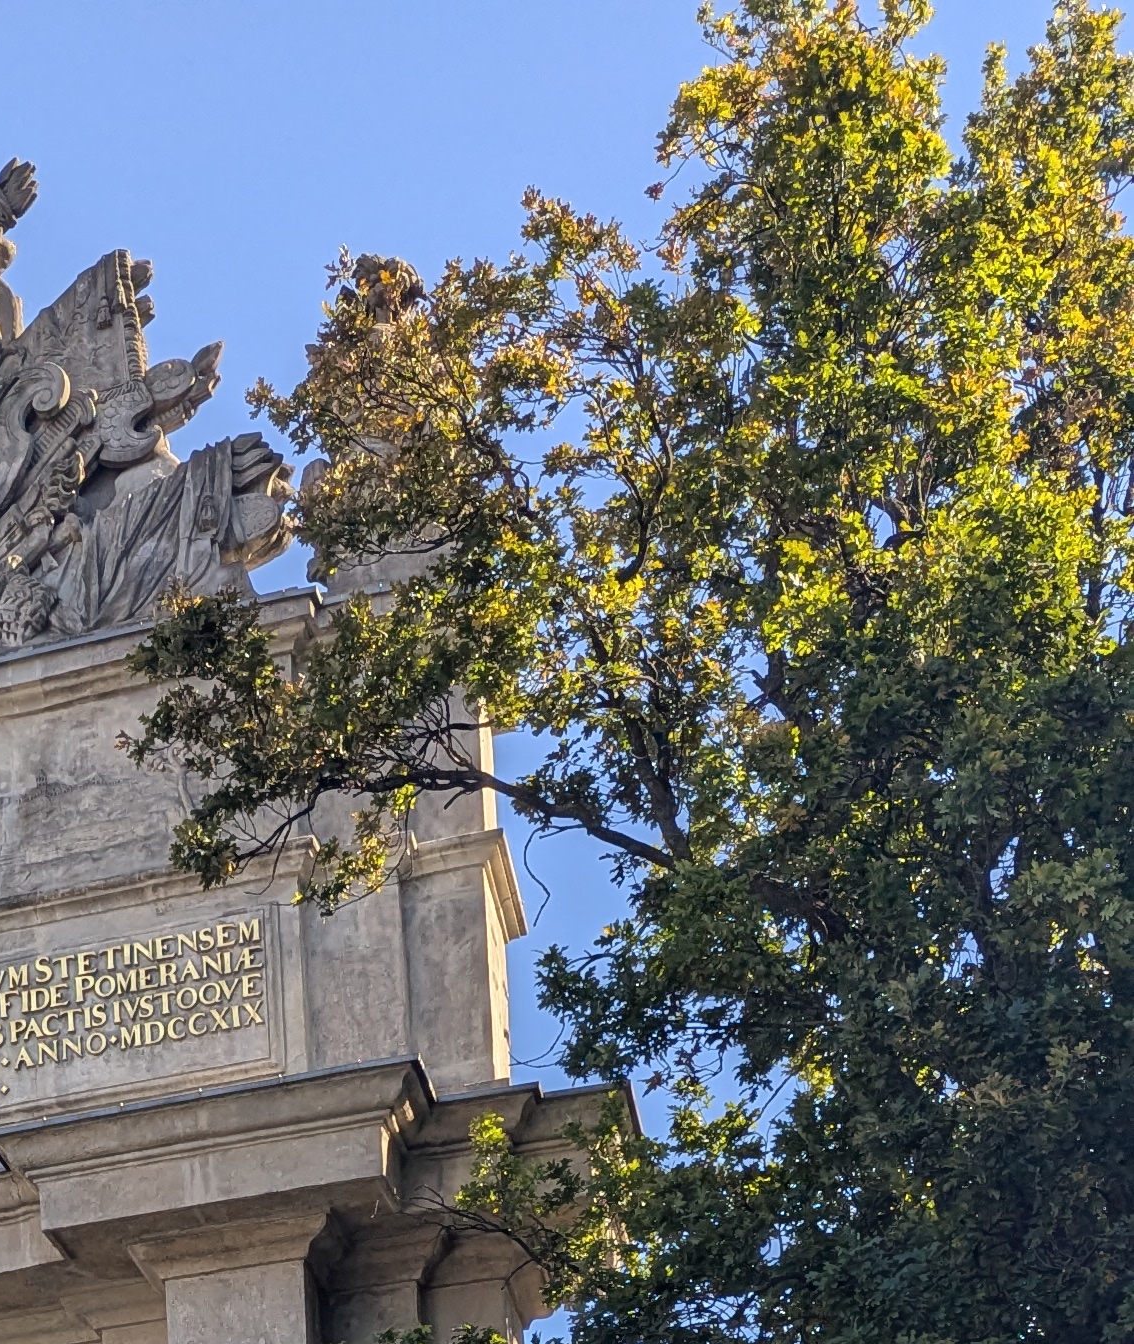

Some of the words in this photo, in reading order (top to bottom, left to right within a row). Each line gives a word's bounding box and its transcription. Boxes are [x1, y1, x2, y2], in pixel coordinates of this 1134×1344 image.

[0, 984, 68, 1019] FIDE
[75, 946, 262, 1002] POMERANIÆ
[35, 919, 261, 983] STETINENSEM
[10, 1003, 107, 1043] PACTIS
[113, 973, 262, 1024] IVSTOQVE
[120, 1000, 264, 1050] MDCCXIX
